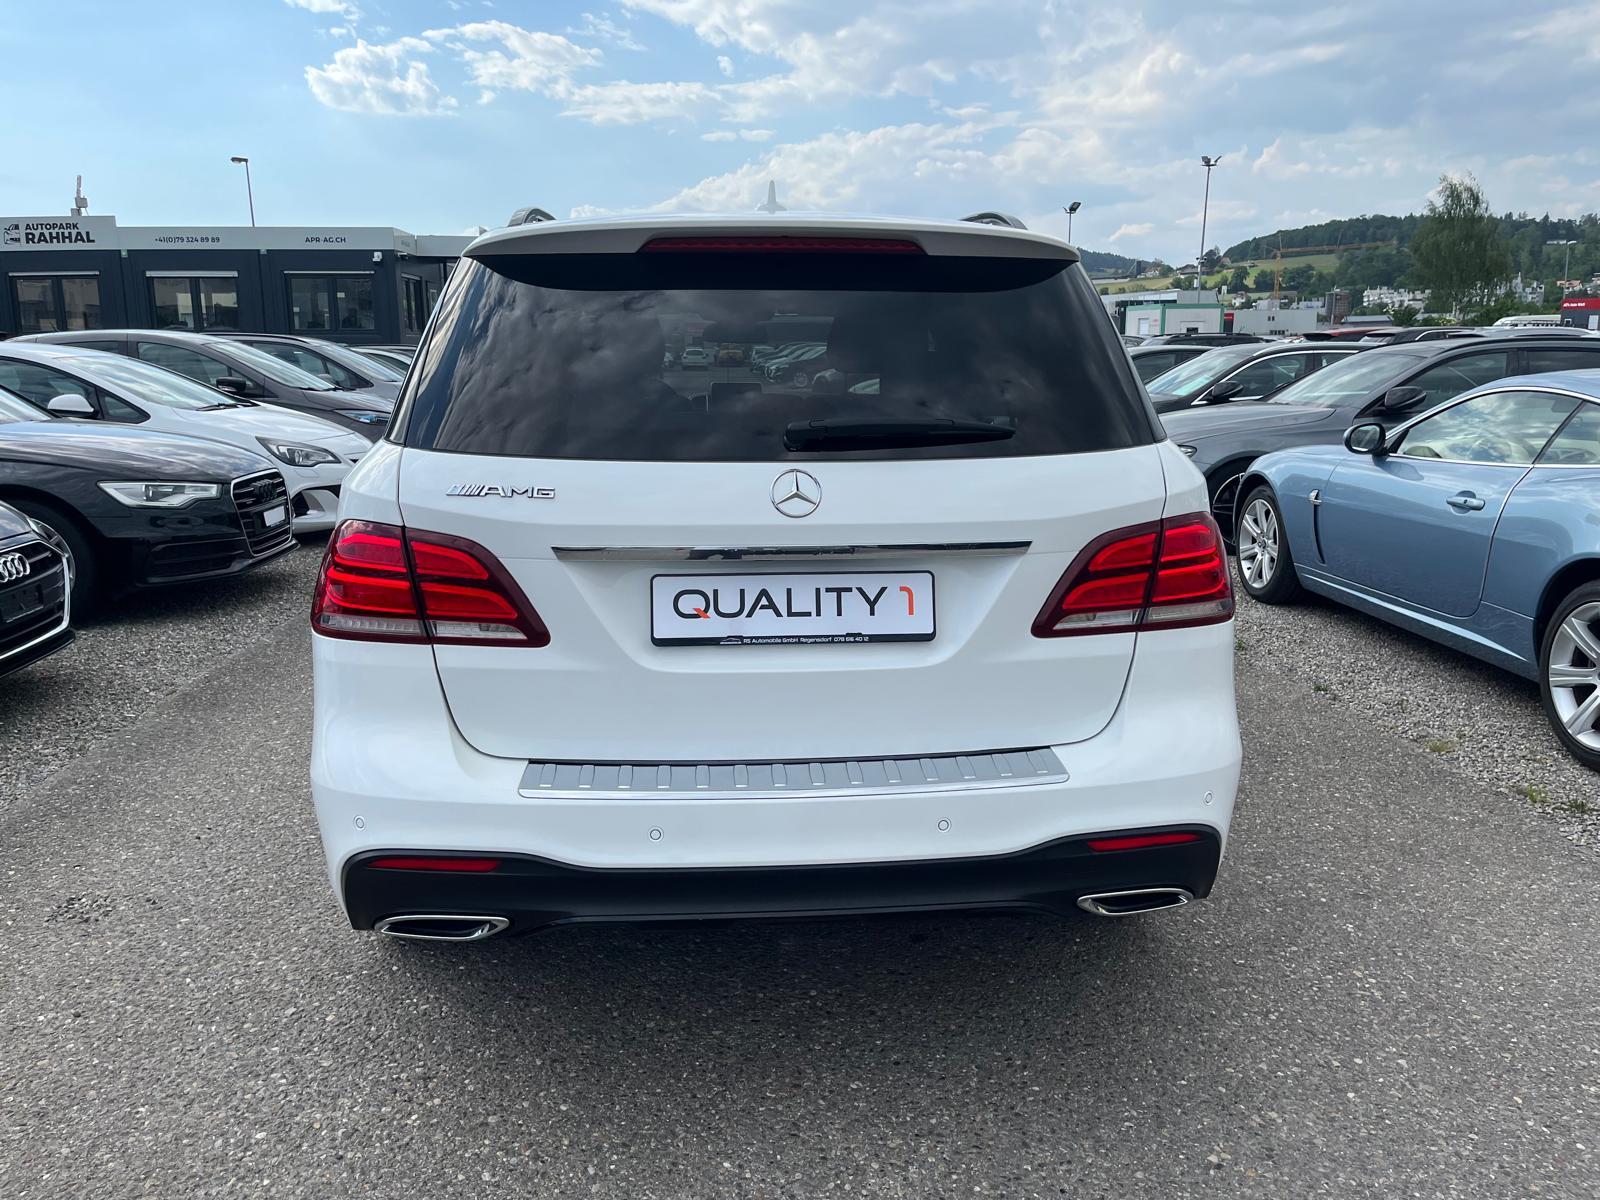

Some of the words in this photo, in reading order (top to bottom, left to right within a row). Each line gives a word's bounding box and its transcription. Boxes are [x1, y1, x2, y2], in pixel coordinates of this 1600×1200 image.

[25, 223, 79, 231] AUTOPARK
[25, 231, 95, 244] RAHHAL
[477, 485, 556, 499] AMG
[672, 586, 888, 619] QUALITY
[899, 585, 914, 616] 1
